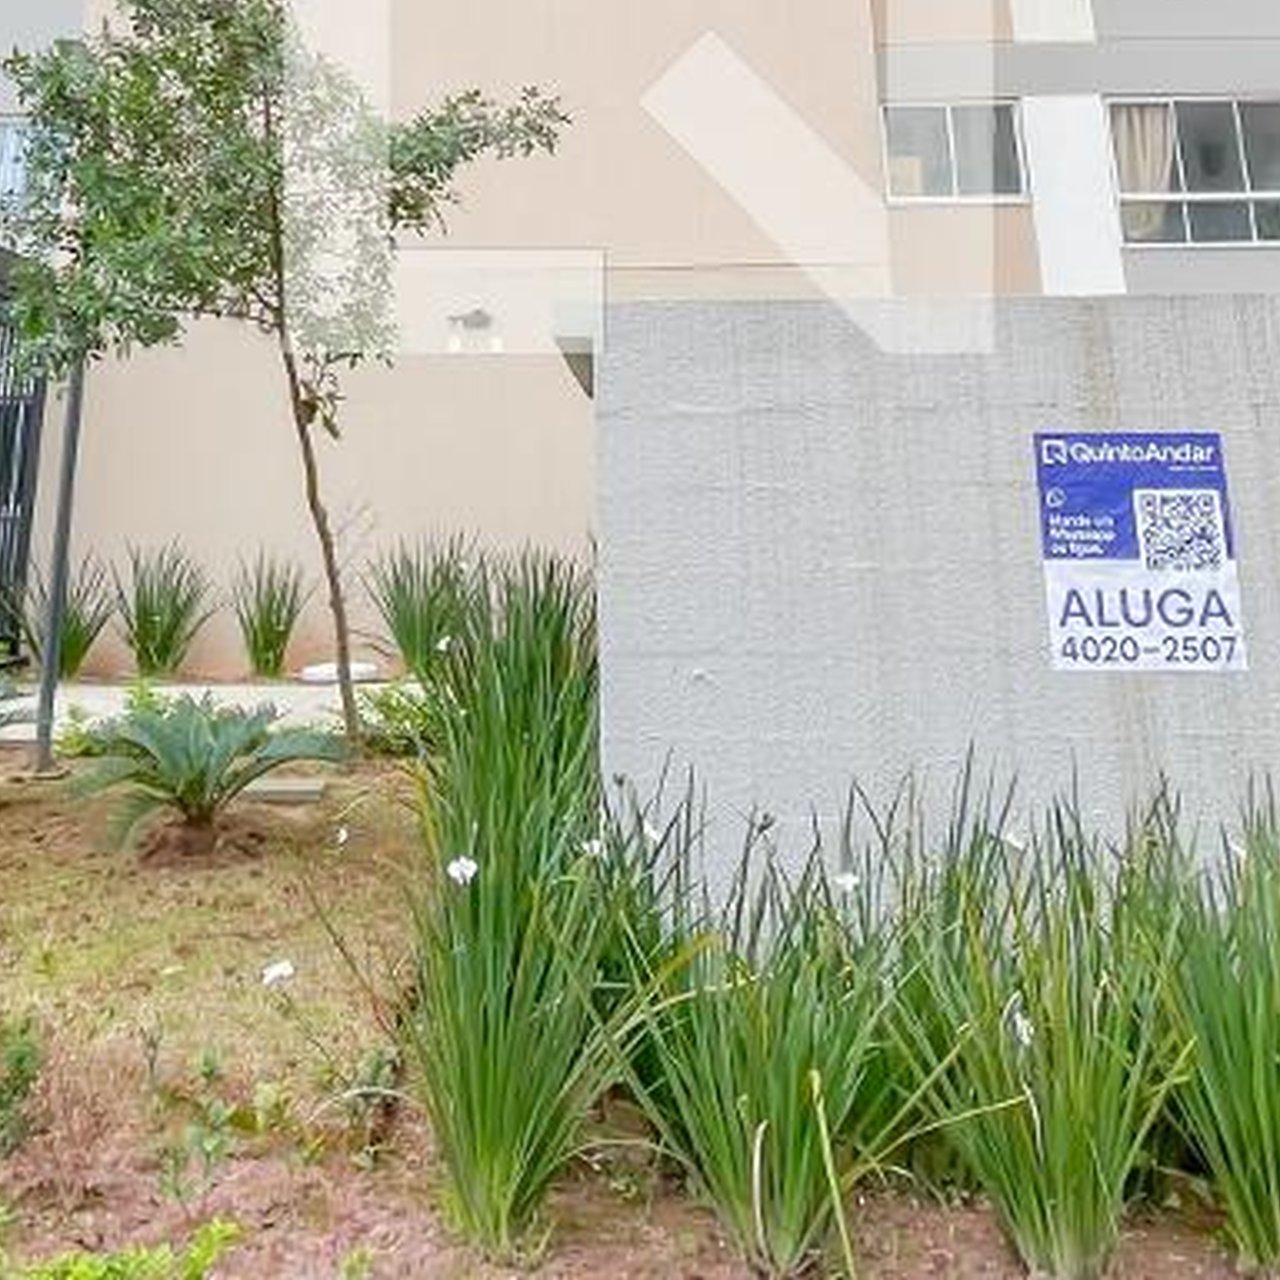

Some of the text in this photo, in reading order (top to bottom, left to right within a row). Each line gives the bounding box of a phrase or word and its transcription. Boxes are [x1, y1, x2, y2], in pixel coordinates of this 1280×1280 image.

[1070, 442, 1213, 464] QuintoAndar
[1059, 588, 1234, 628] ALUGA
[1061, 636, 1237, 663] 4020-2507
